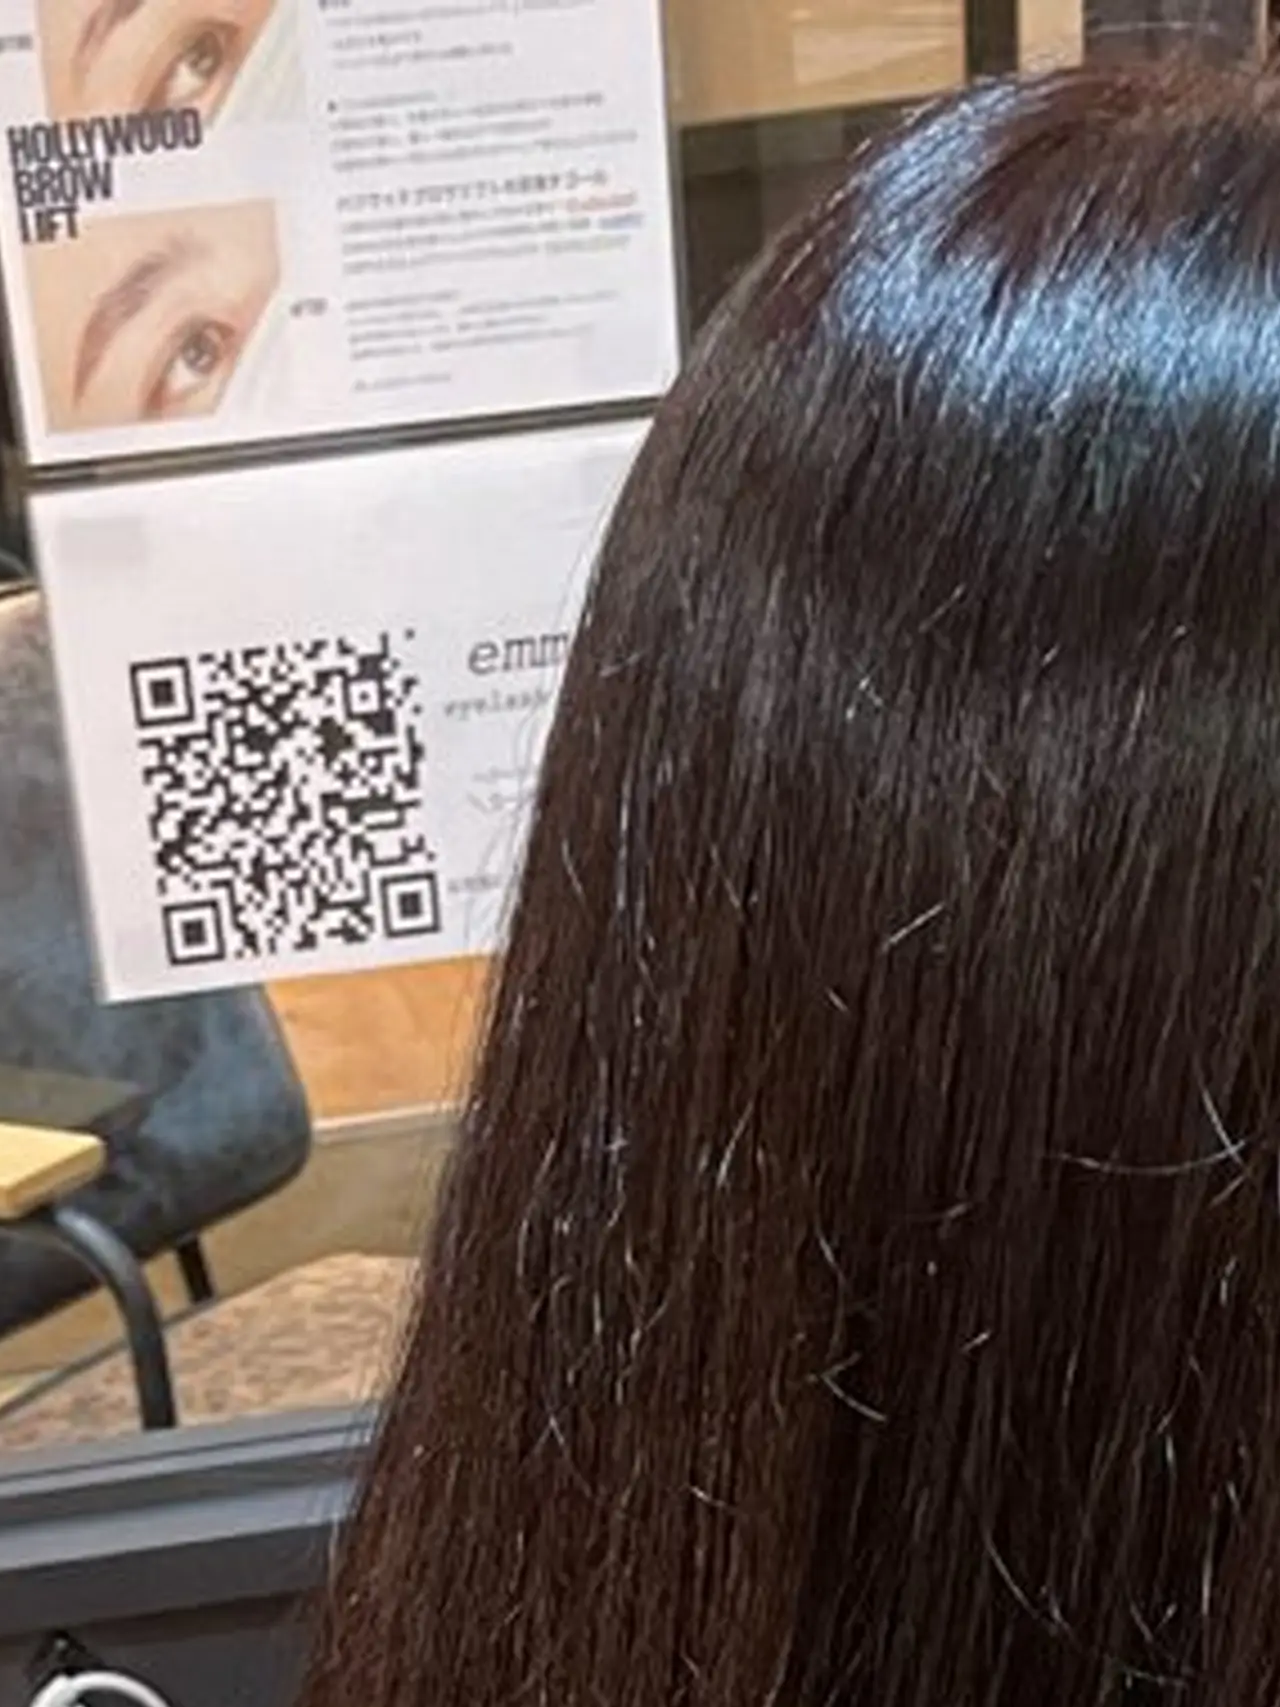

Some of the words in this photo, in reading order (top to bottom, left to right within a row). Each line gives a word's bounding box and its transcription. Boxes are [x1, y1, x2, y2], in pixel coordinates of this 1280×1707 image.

[7, 107, 203, 166] HOLLYWOOD
[15, 160, 113, 207] BROW
[18, 207, 79, 243] LIFT
